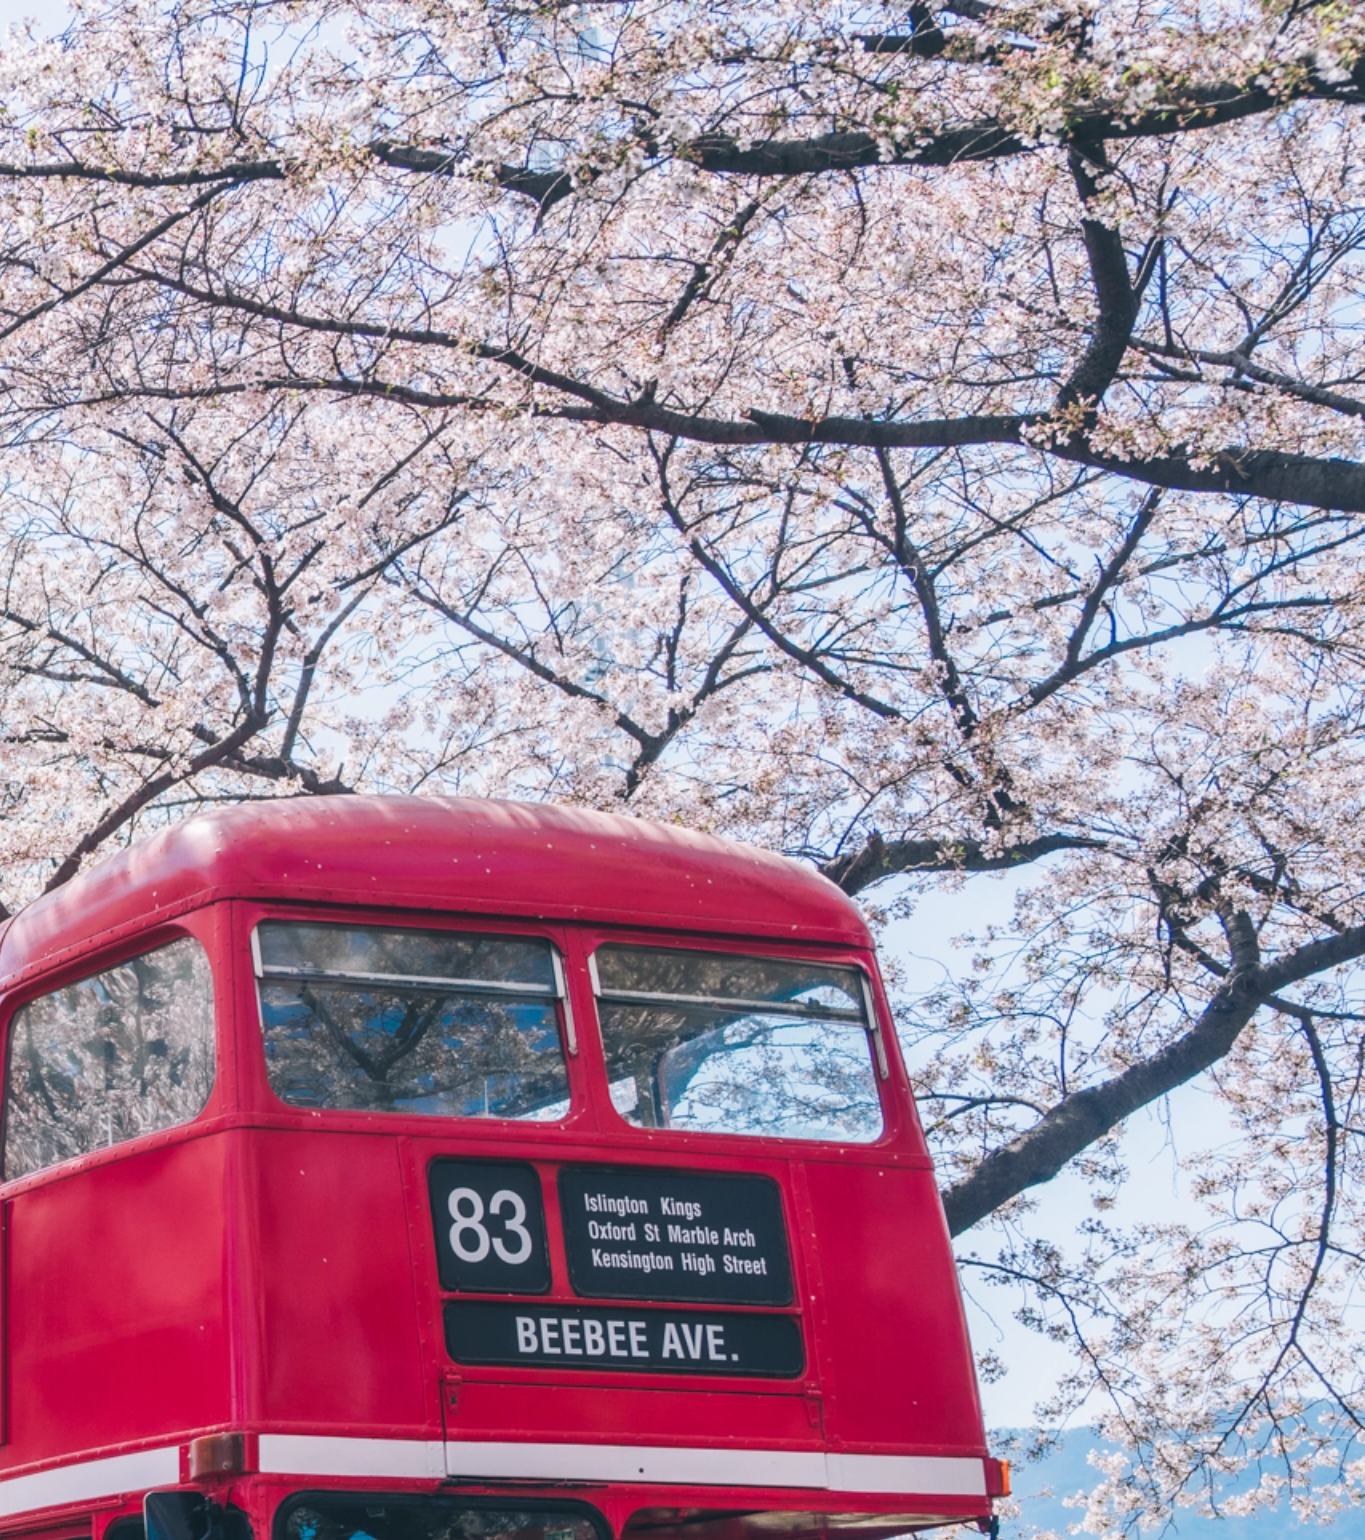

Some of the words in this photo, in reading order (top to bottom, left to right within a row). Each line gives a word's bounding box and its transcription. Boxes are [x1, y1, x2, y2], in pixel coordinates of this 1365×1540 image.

[584, 1193, 649, 1216] Islington
[660, 1196, 702, 1221] Kings
[447, 1186, 533, 1266] 83
[588, 1221, 637, 1243] Oxford
[644, 1223, 661, 1243] St
[668, 1225, 720, 1246] Marble
[723, 1227, 756, 1248] Arch
[591, 1249, 673, 1274] Kensington
[681, 1253, 717, 1276] High
[723, 1255, 768, 1276] Street
[515, 1316, 650, 1359] BEEBEE
[661, 1322, 739, 1362] AVE.
